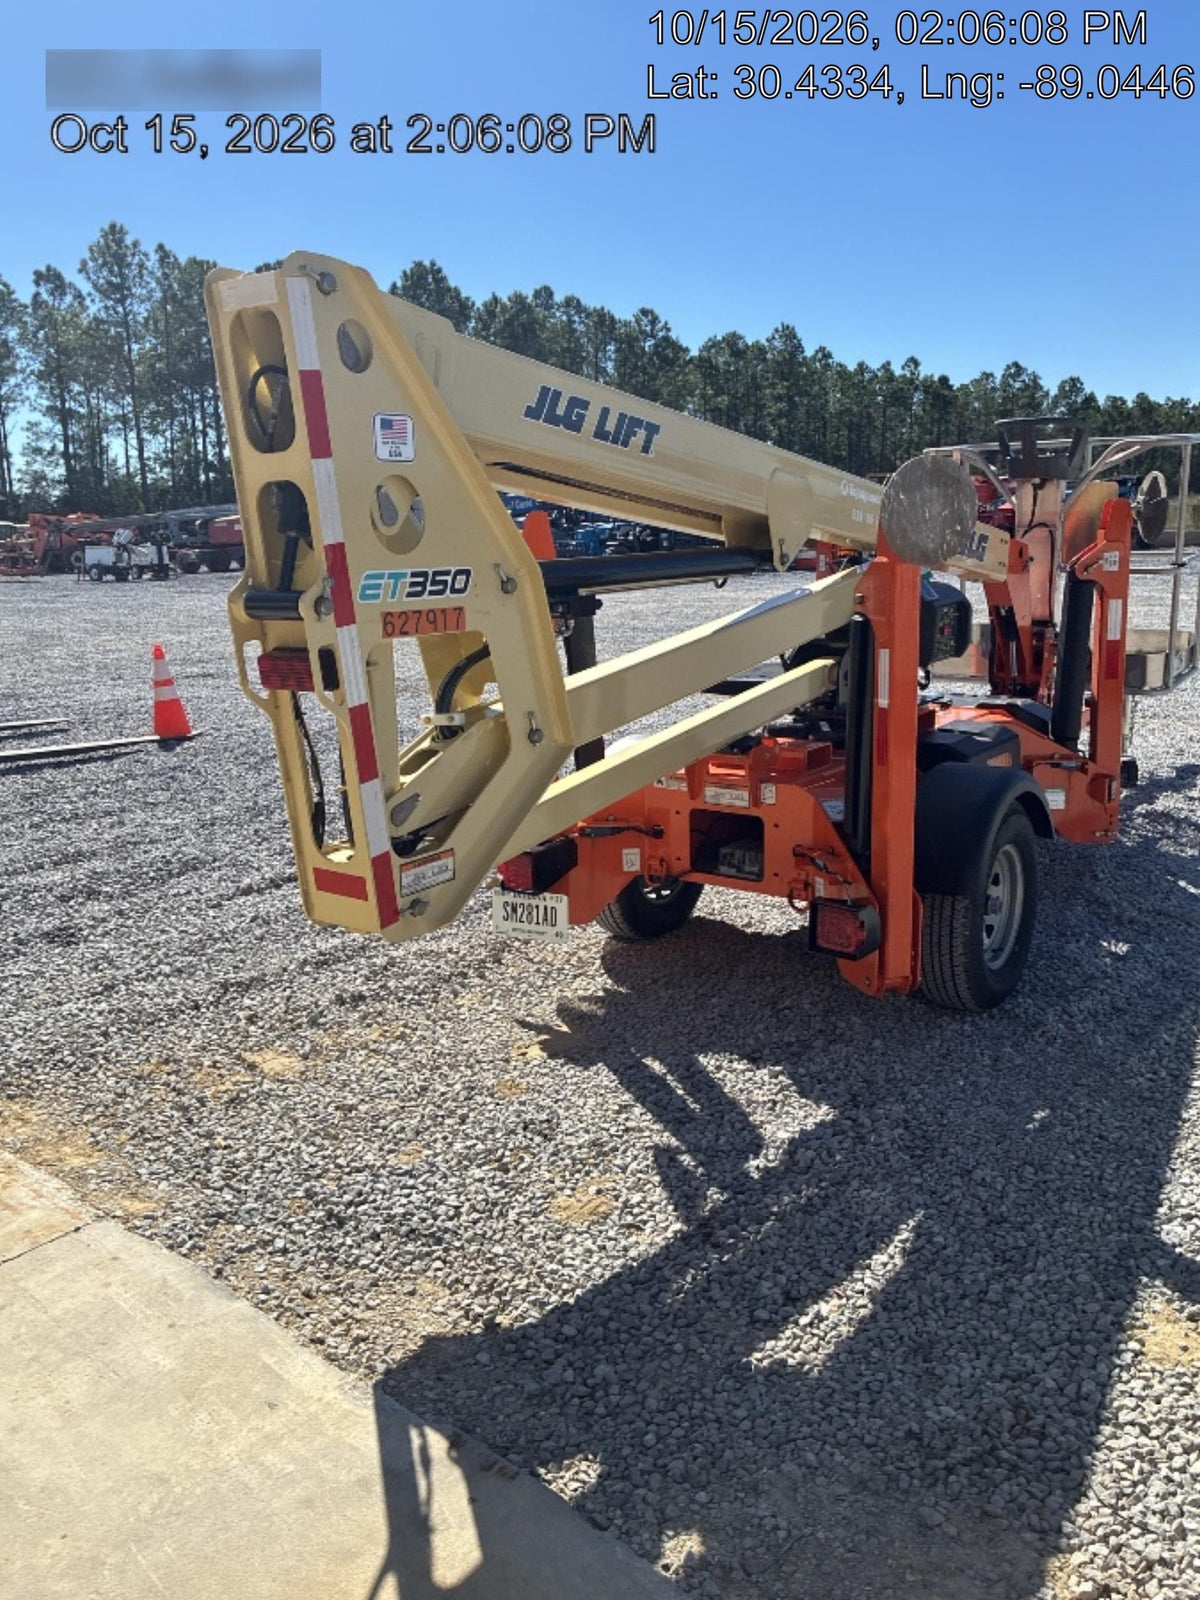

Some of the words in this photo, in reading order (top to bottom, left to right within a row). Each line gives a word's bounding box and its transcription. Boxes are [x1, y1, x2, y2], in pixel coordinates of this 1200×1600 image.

[523, 384, 591, 434] JLG
[592, 405, 661, 455] LIFT
[960, 530, 989, 562] LG
[358, 568, 472, 602] ET350
[383, 606, 463, 637] 627917
